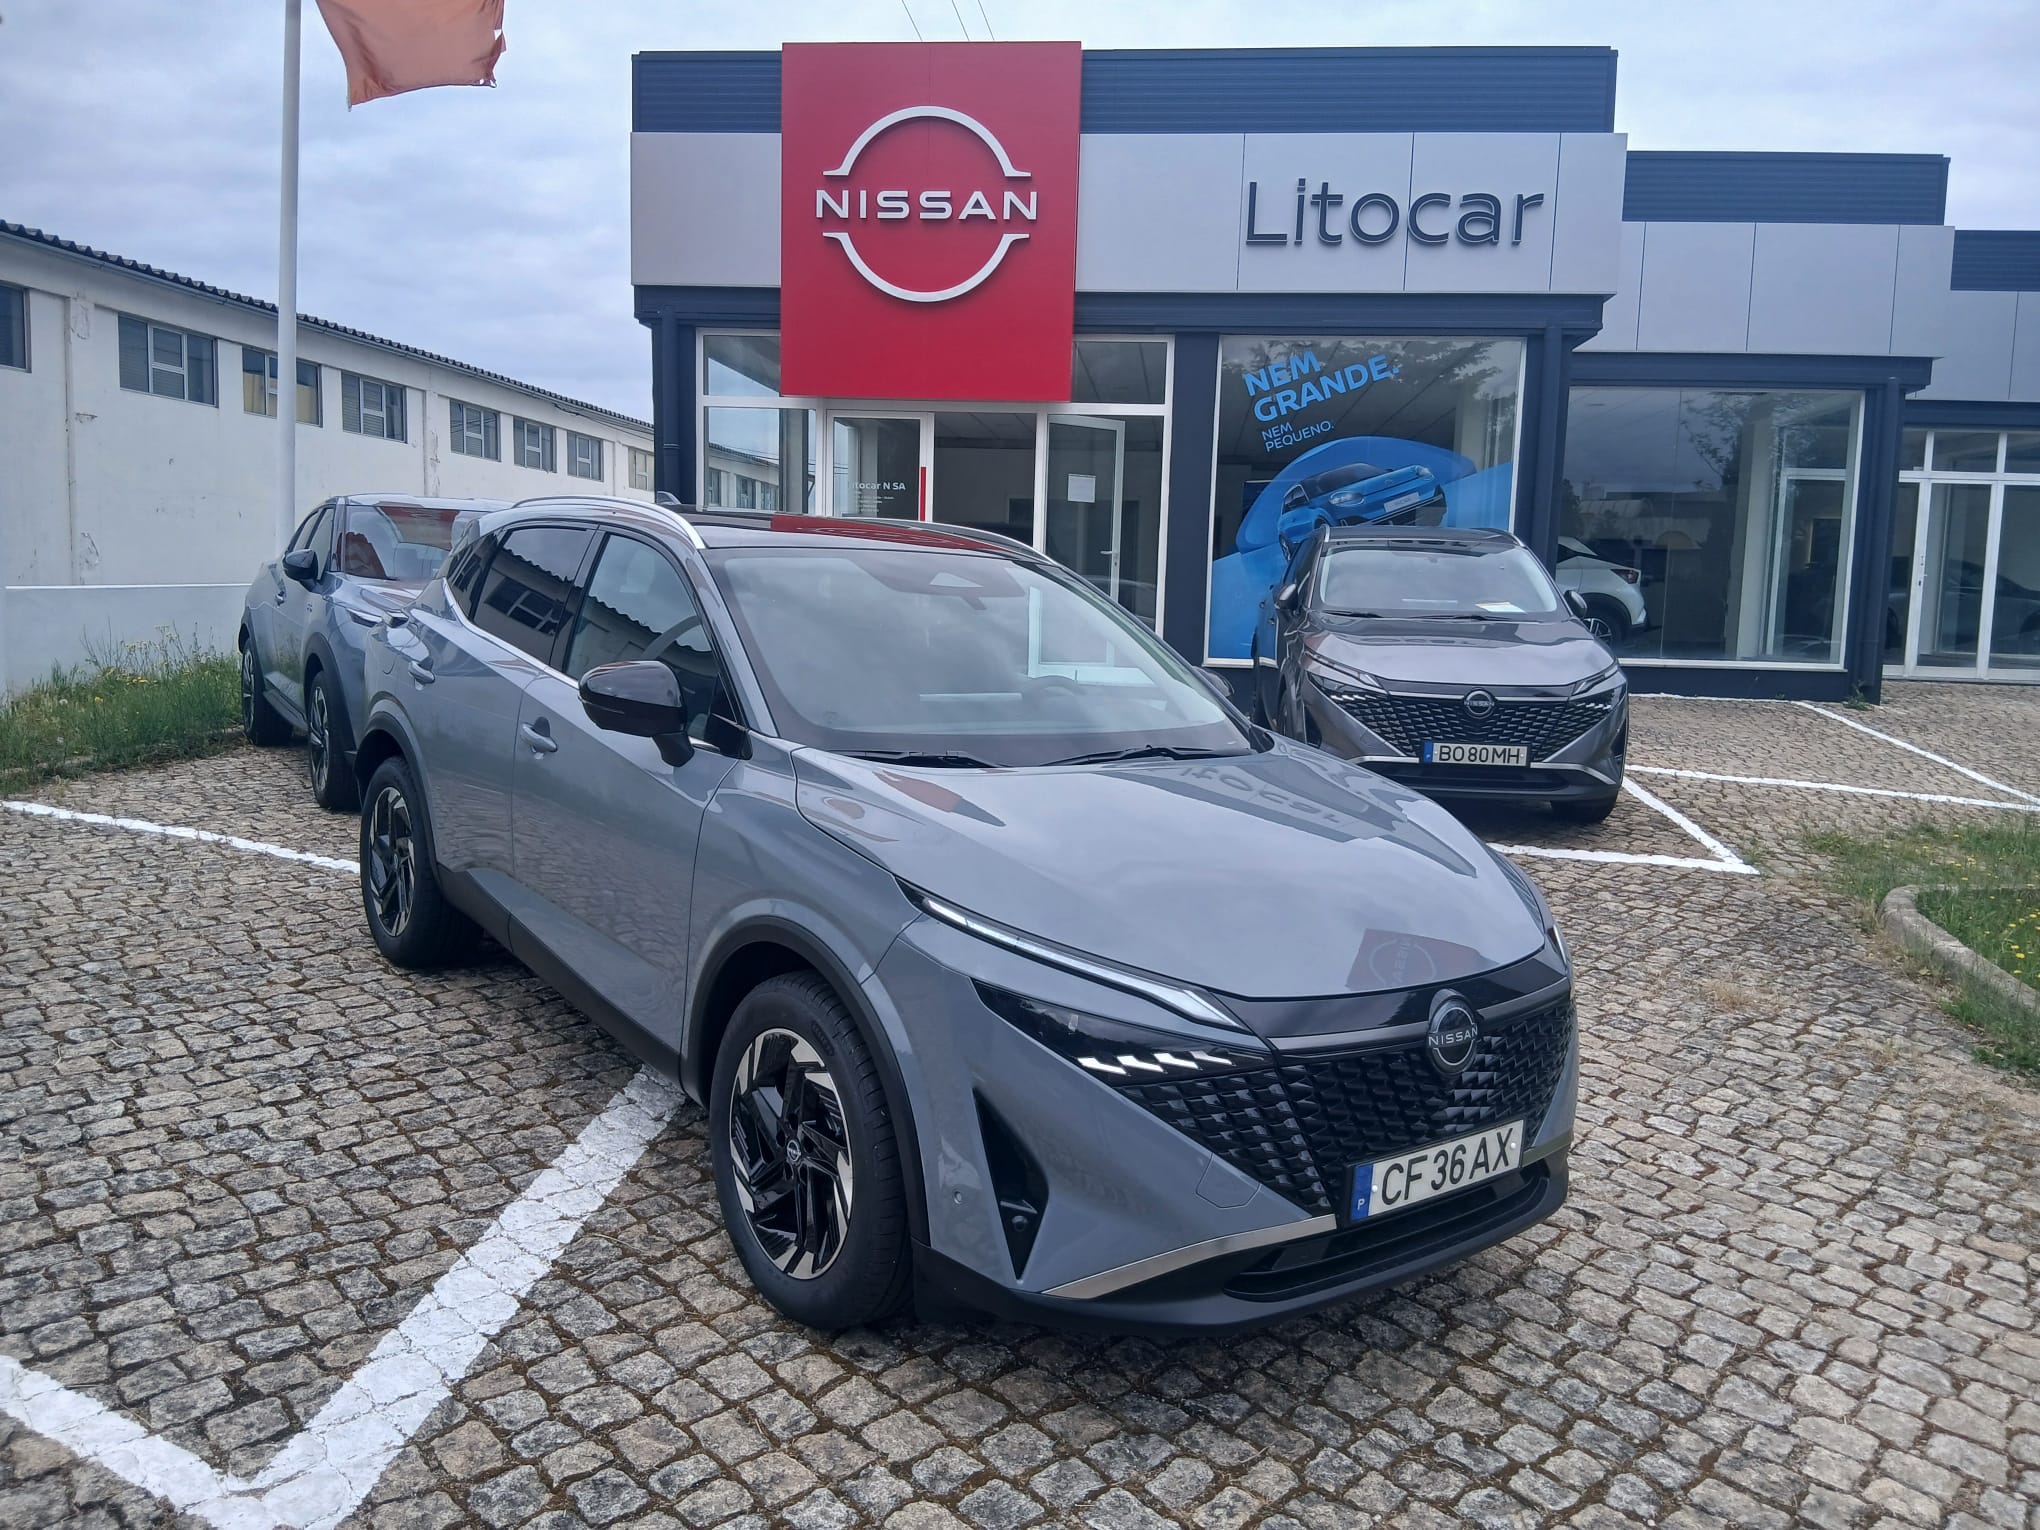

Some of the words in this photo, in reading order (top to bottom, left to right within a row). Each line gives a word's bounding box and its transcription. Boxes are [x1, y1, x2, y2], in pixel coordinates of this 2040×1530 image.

[816, 189, 1038, 220] NISSAN
[1246, 178, 1545, 245] Litocar
[1243, 351, 1321, 396] NEM
[1254, 354, 1399, 422] GRANDE.
[1261, 422, 1293, 441] NEM
[1265, 420, 1334, 452] PEQUENO.
[883, 482, 890, 490] N
[892, 482, 906, 490] SA
[1428, 1025, 1478, 1047] NISSAN
[1357, 1198, 1365, 1210] P
